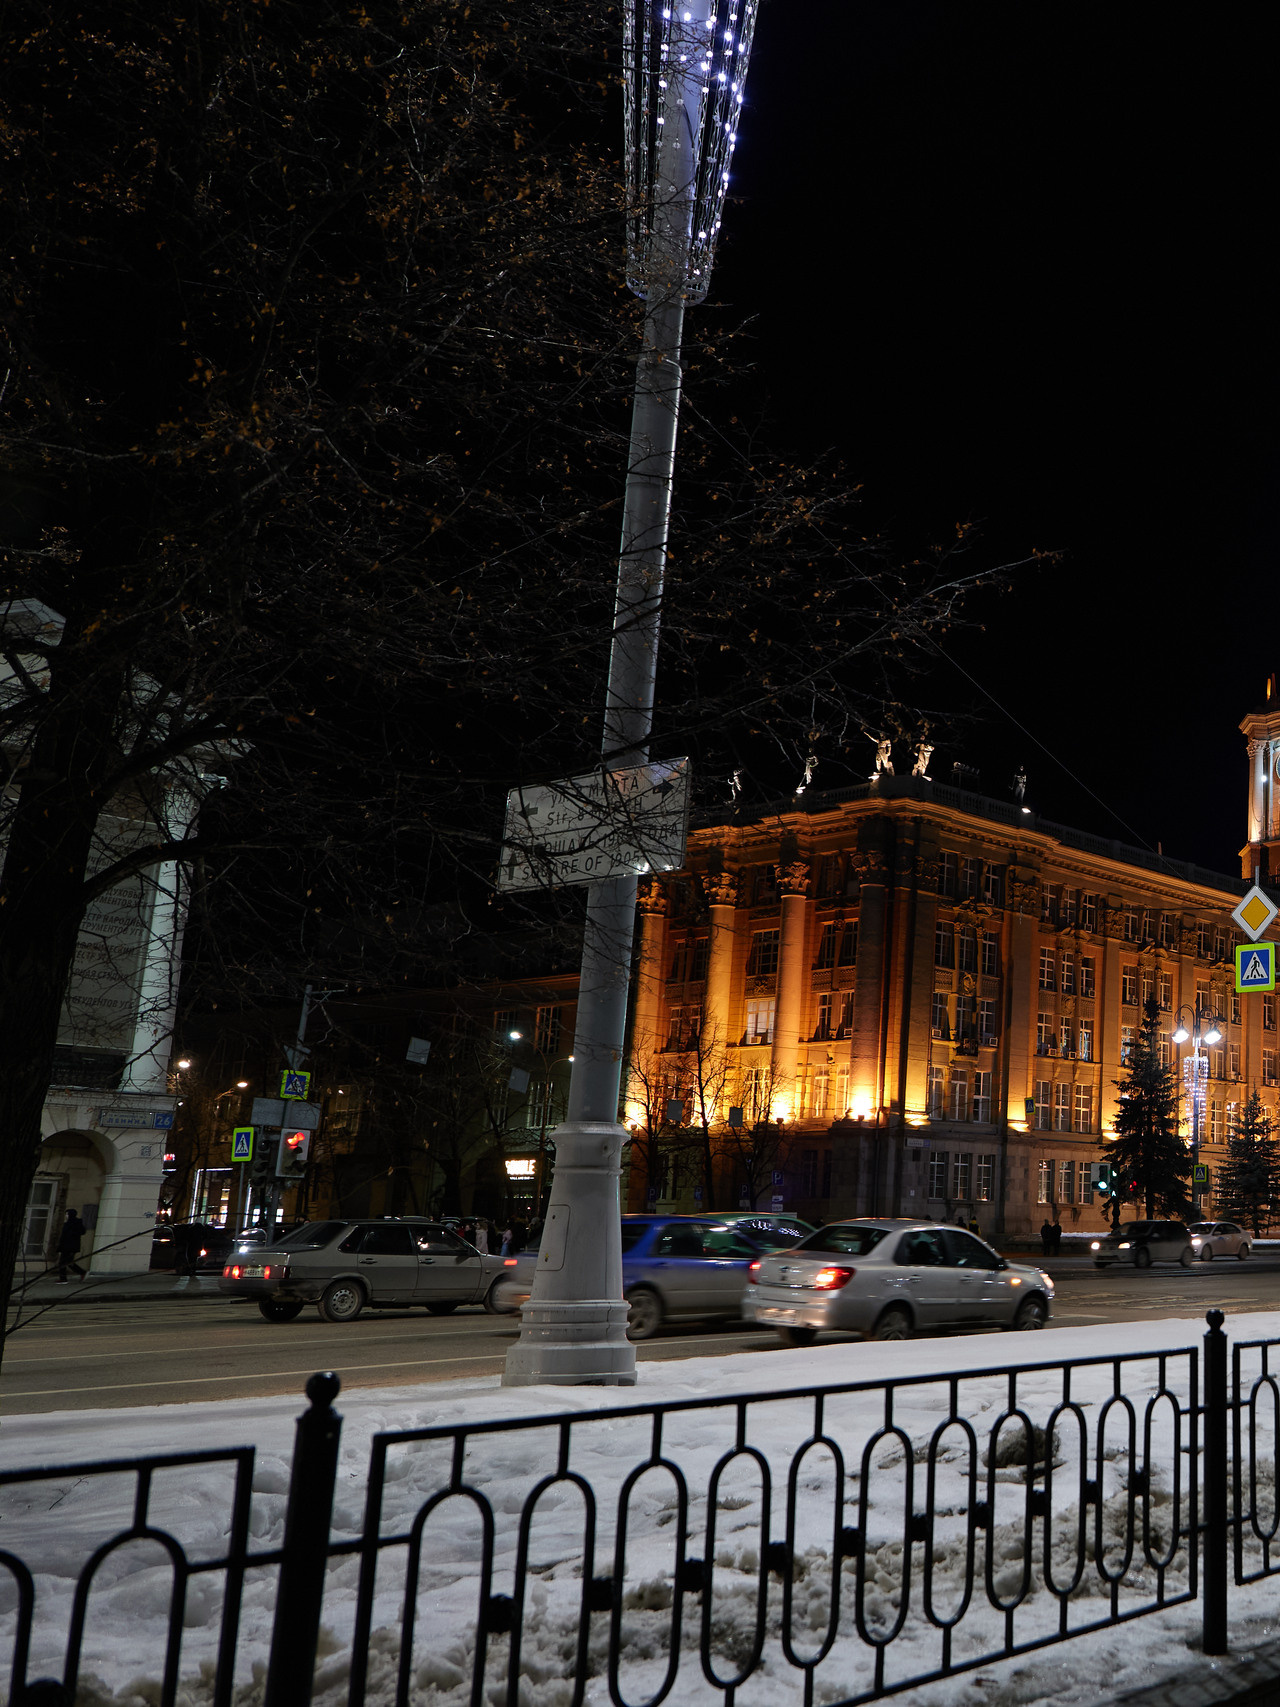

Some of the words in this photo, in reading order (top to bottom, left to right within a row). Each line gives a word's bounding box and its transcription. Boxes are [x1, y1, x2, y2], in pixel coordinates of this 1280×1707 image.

[585, 855, 602, 871] OF
[610, 850, 640, 868] 1905
[157, 1115, 171, 1126] 26
